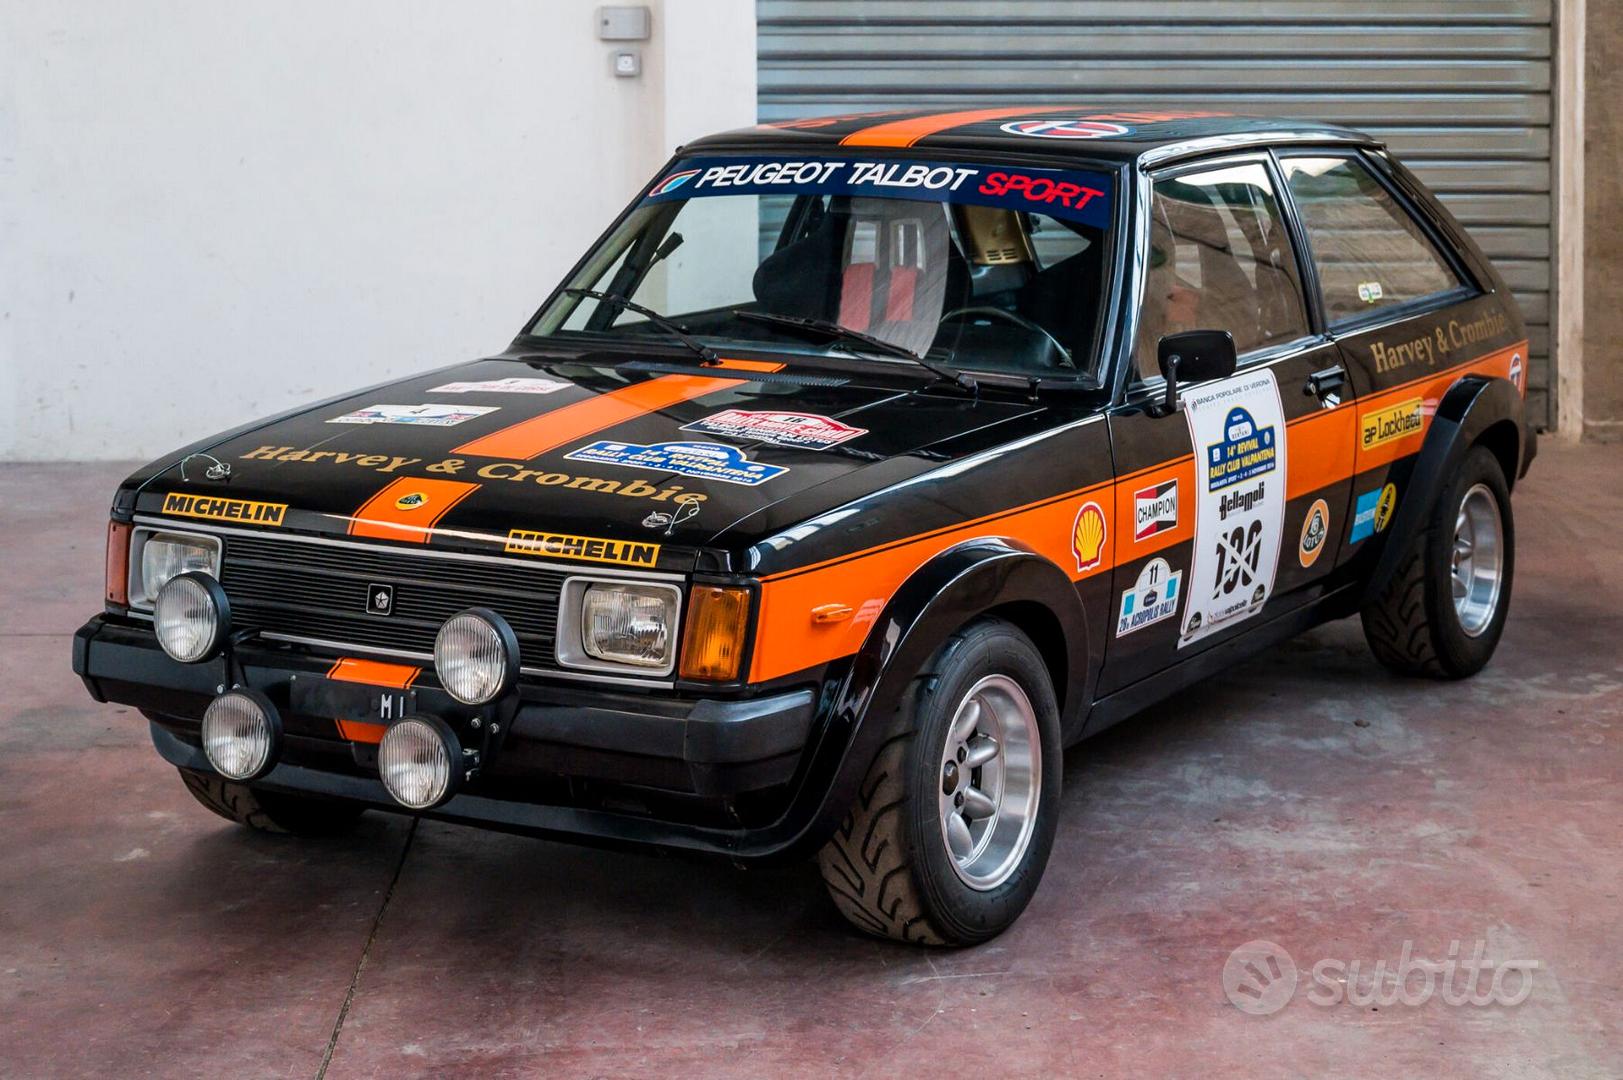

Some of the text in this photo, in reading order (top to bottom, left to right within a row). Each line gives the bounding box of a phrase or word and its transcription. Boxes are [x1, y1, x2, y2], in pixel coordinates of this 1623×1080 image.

[695, 162, 1104, 211] PEUGEOT TALBOT SPORT
[1370, 336, 1435, 373] Harvey
[1435, 326, 1451, 354] &
[1377, 404, 1421, 439] Lockheed
[239, 445, 709, 504] Harvey & Crombie
[165, 495, 282, 522] MICHELIN
[1138, 496, 1176, 524] CHAMPION
[1218, 480, 1265, 521] Bellamoli
[508, 532, 655, 564] MICHELIN
[1149, 562, 1159, 585] 11
[1130, 604, 1160, 627] ACROPOLIS
[1159, 598, 1176, 616] RALLY
